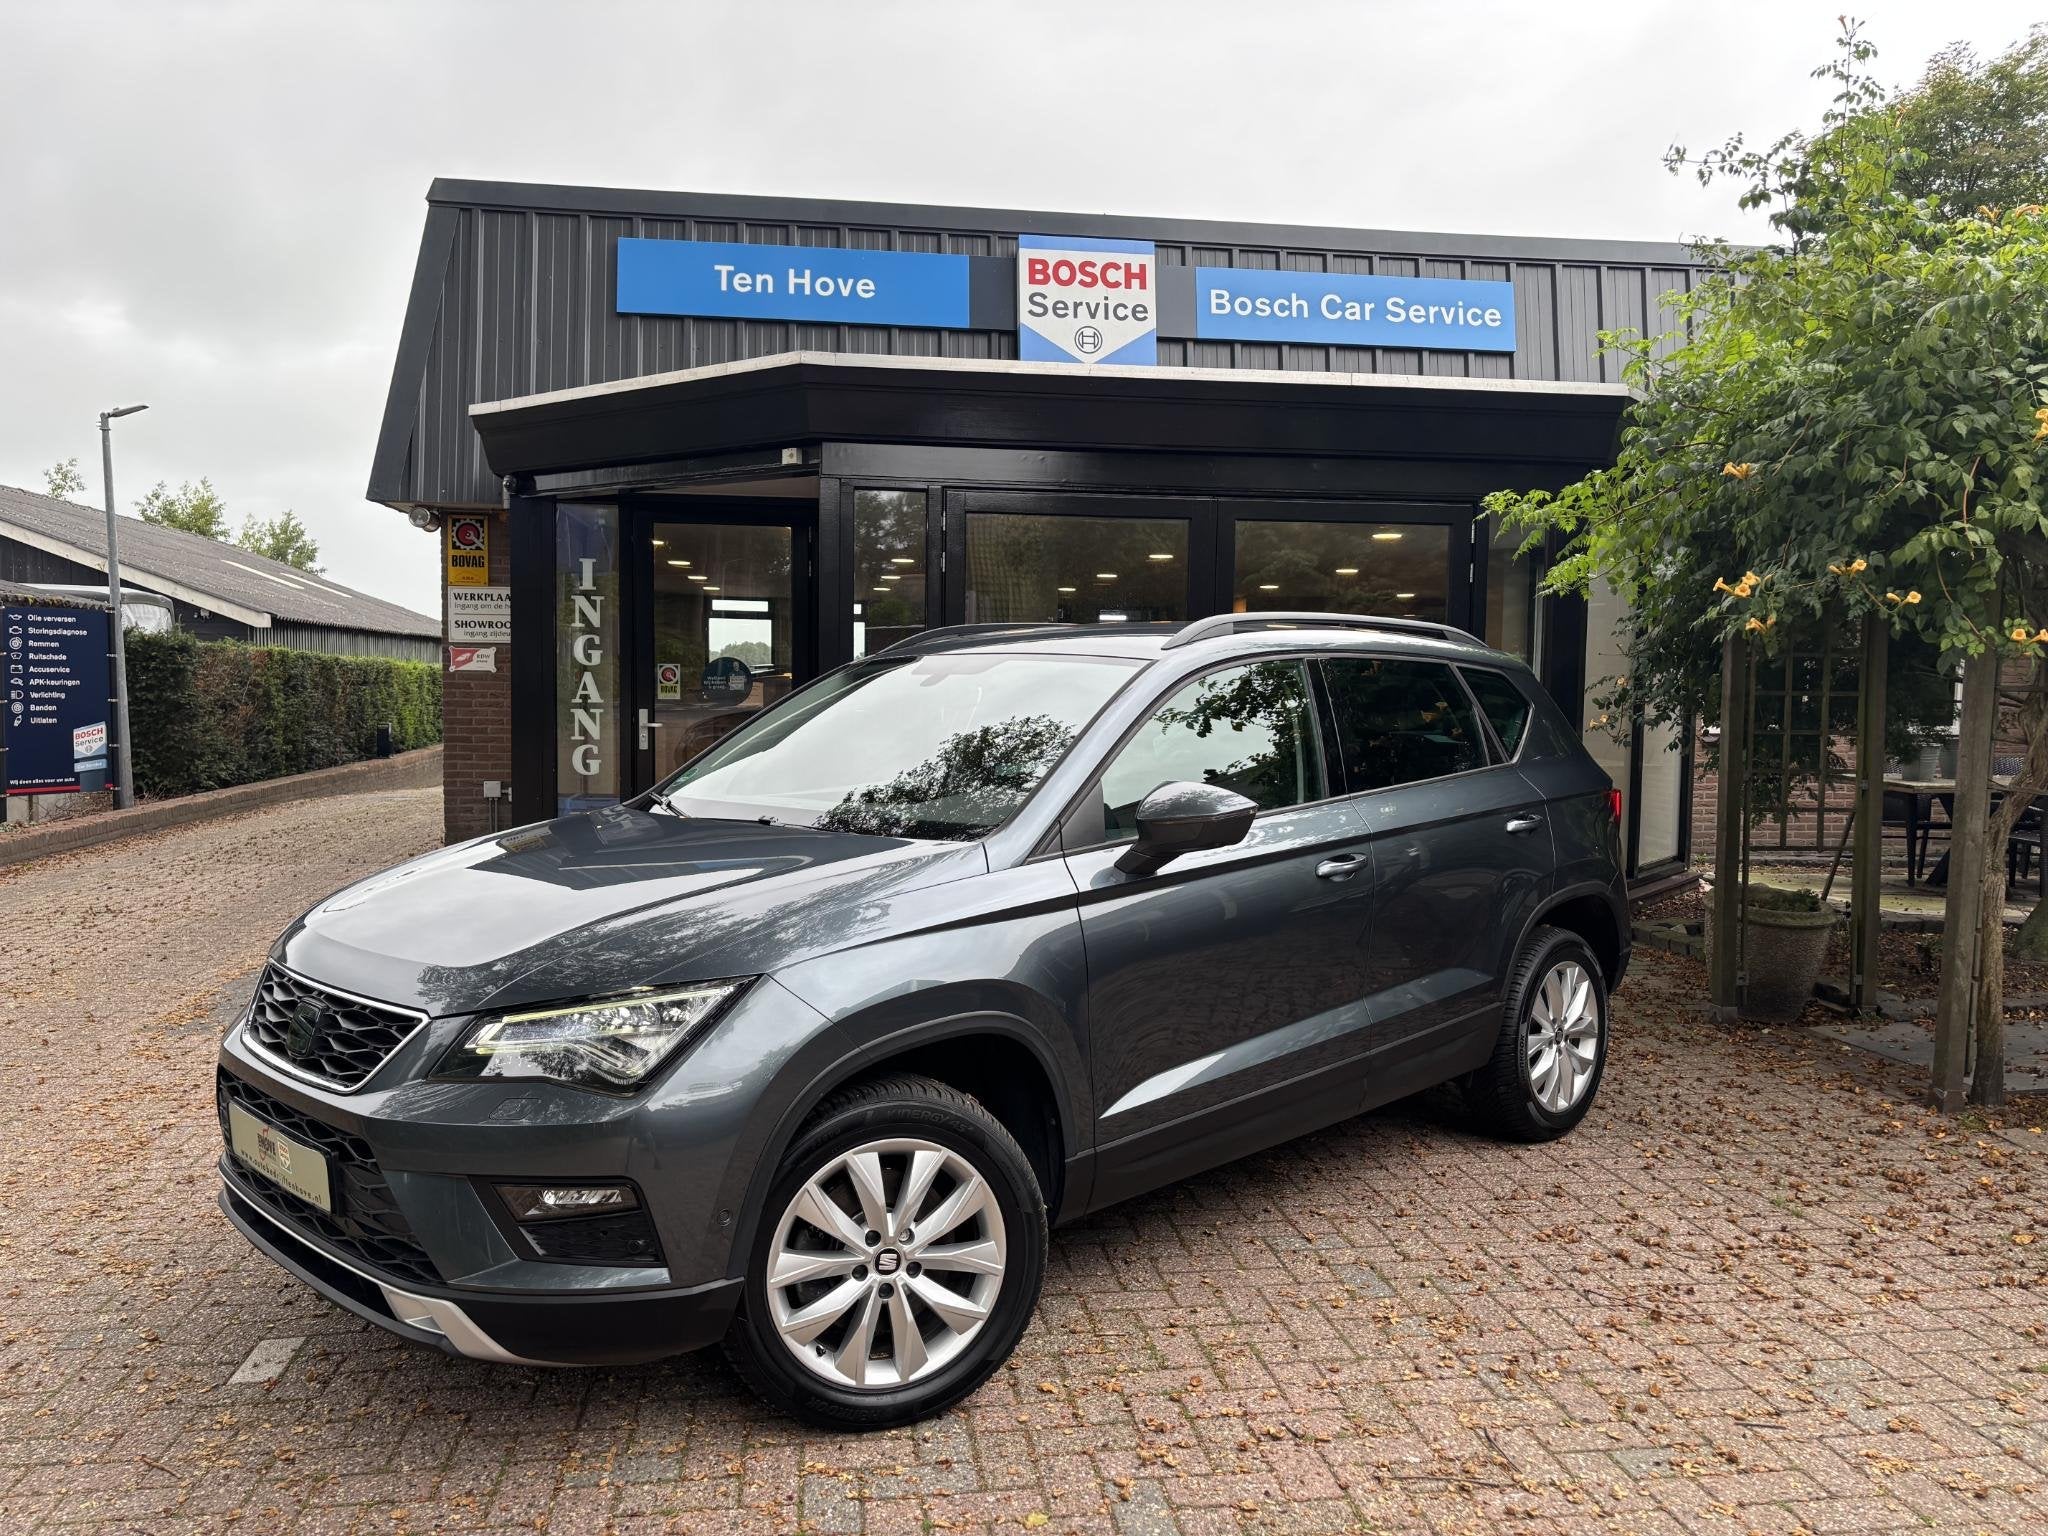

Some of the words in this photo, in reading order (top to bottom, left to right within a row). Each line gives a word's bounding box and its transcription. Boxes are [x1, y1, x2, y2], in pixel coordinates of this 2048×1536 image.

[1028, 257, 1147, 290] BOSCH
[714, 264, 774, 293] Ten
[788, 268, 876, 299] Hove
[1027, 291, 1149, 322] Service
[1210, 289, 1308, 319] Bosch
[1320, 293, 1375, 321] Car
[1385, 296, 1502, 327] Service
[451, 554, 485, 568] BOVAG
[454, 620, 511, 629] SHOWROO
[28, 627, 88, 636] Storingsdiagnose
[28, 640, 60, 648] Remmen
[570, 557, 606, 776] INGANG
[29, 678, 80, 686] APK-keuringen
[30, 691, 66, 699] Verlichting
[75, 728, 103, 739] BOSCH
[75, 737, 104, 747] Service
